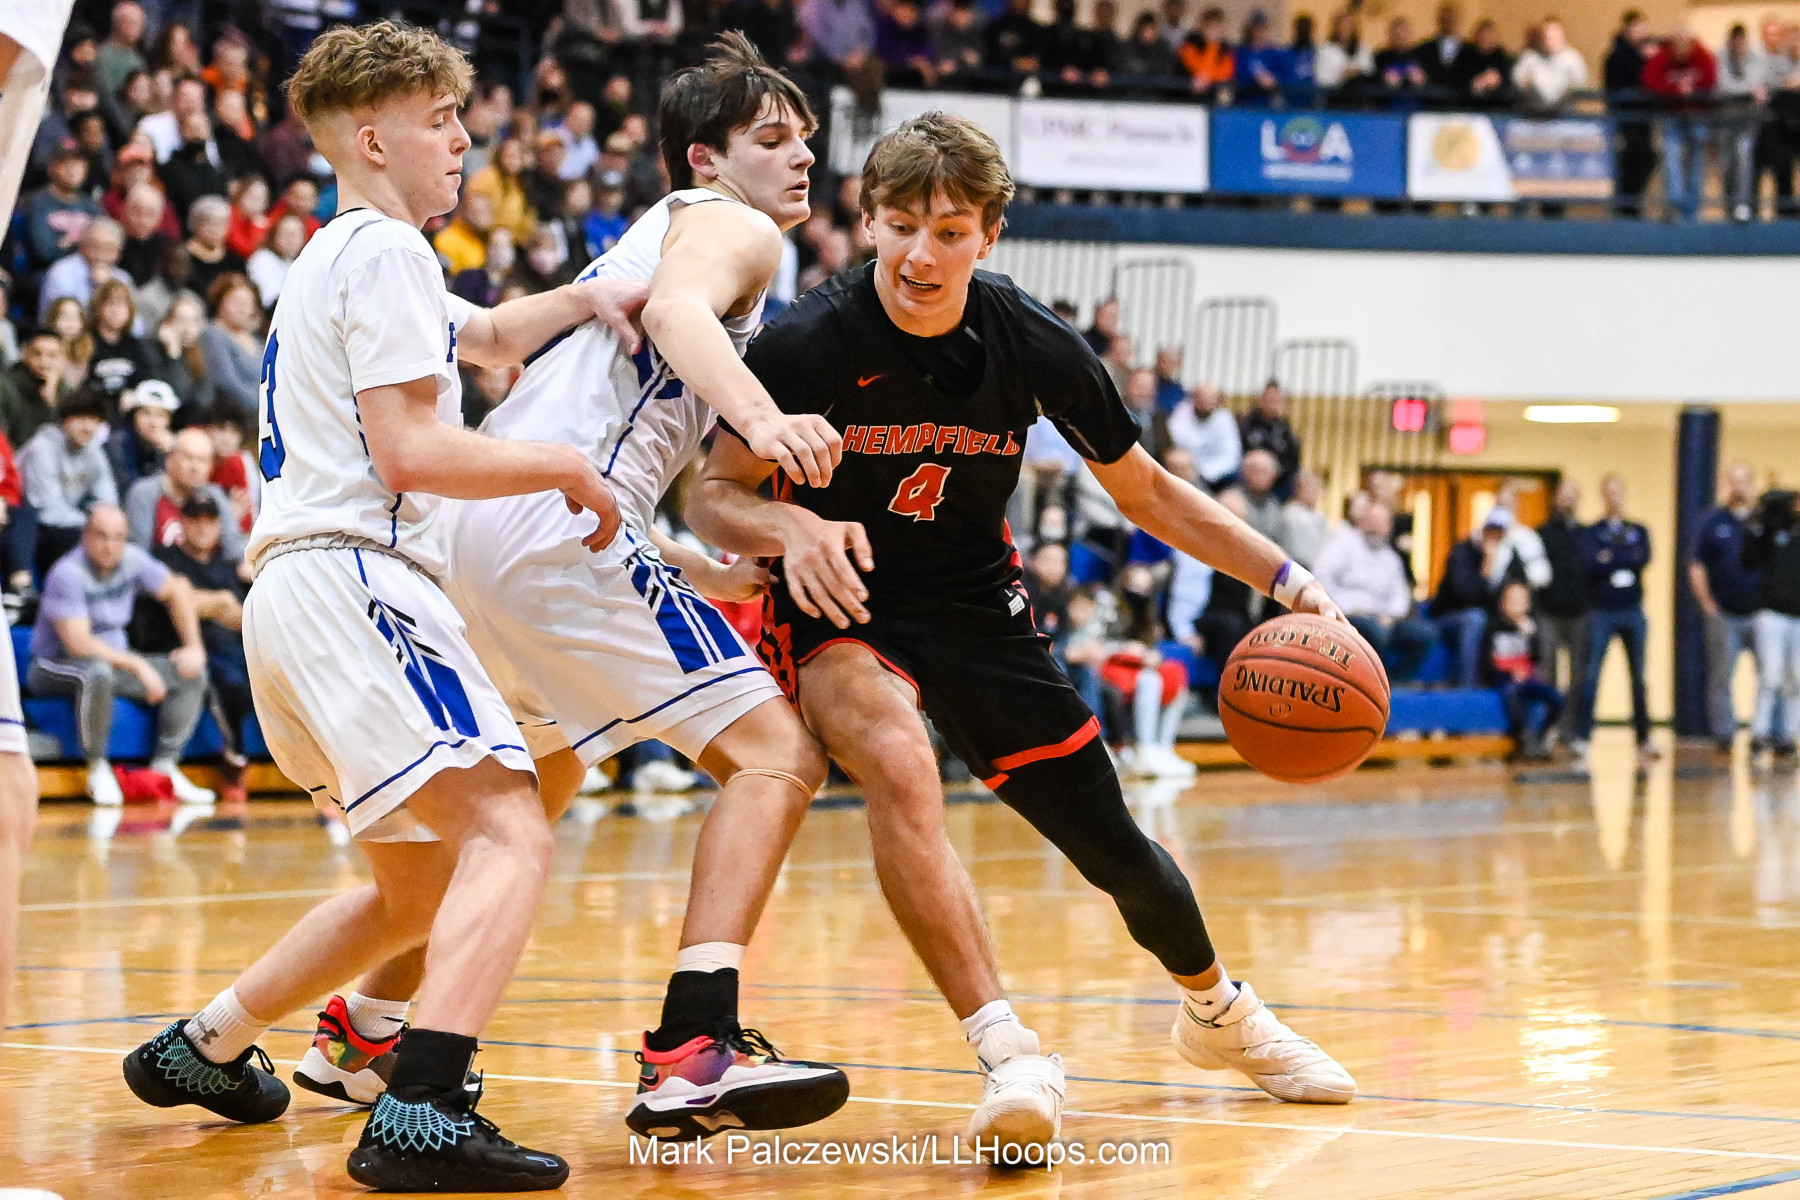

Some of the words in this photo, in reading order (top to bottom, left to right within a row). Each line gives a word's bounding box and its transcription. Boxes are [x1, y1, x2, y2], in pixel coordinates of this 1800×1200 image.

[842, 422, 1021, 456] HEMPFIELD
[887, 462, 952, 523] 4
[1233, 663, 1346, 714] SPALDING
